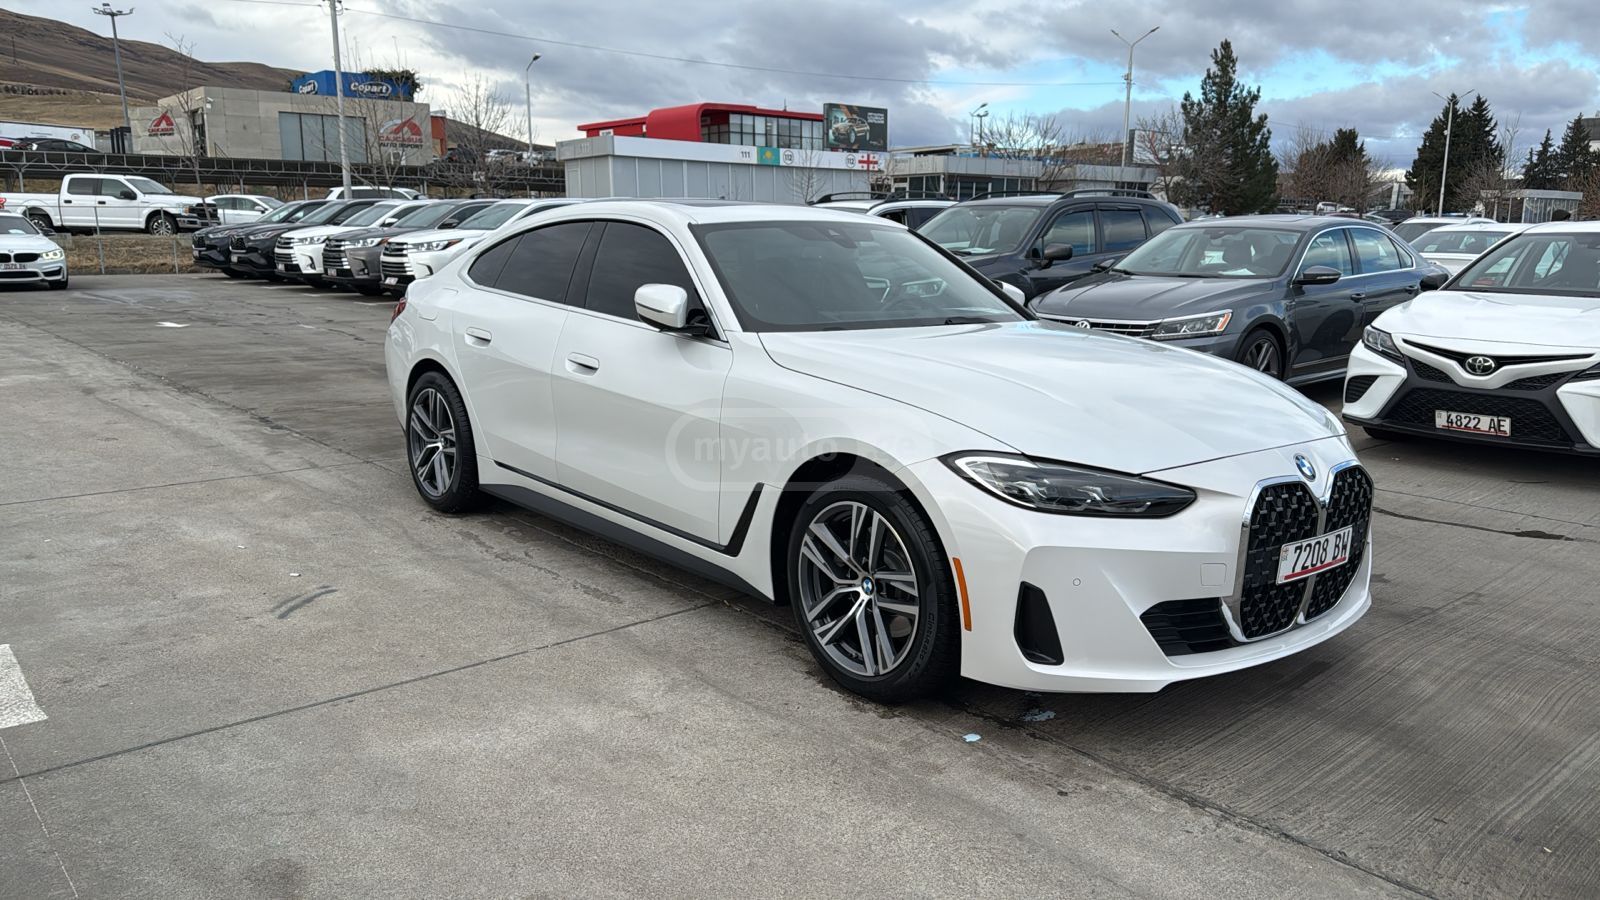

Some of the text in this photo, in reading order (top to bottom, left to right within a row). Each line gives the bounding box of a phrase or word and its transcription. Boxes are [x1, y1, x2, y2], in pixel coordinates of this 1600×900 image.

[298, 82, 314, 94] Copart
[350, 82, 387, 94] Copart
[379, 134, 423, 143] CAUCASUS
[784, 154, 793, 162] 112
[1446, 413, 1507, 433] 4822 AE
[1292, 538, 1329, 573] 7208
